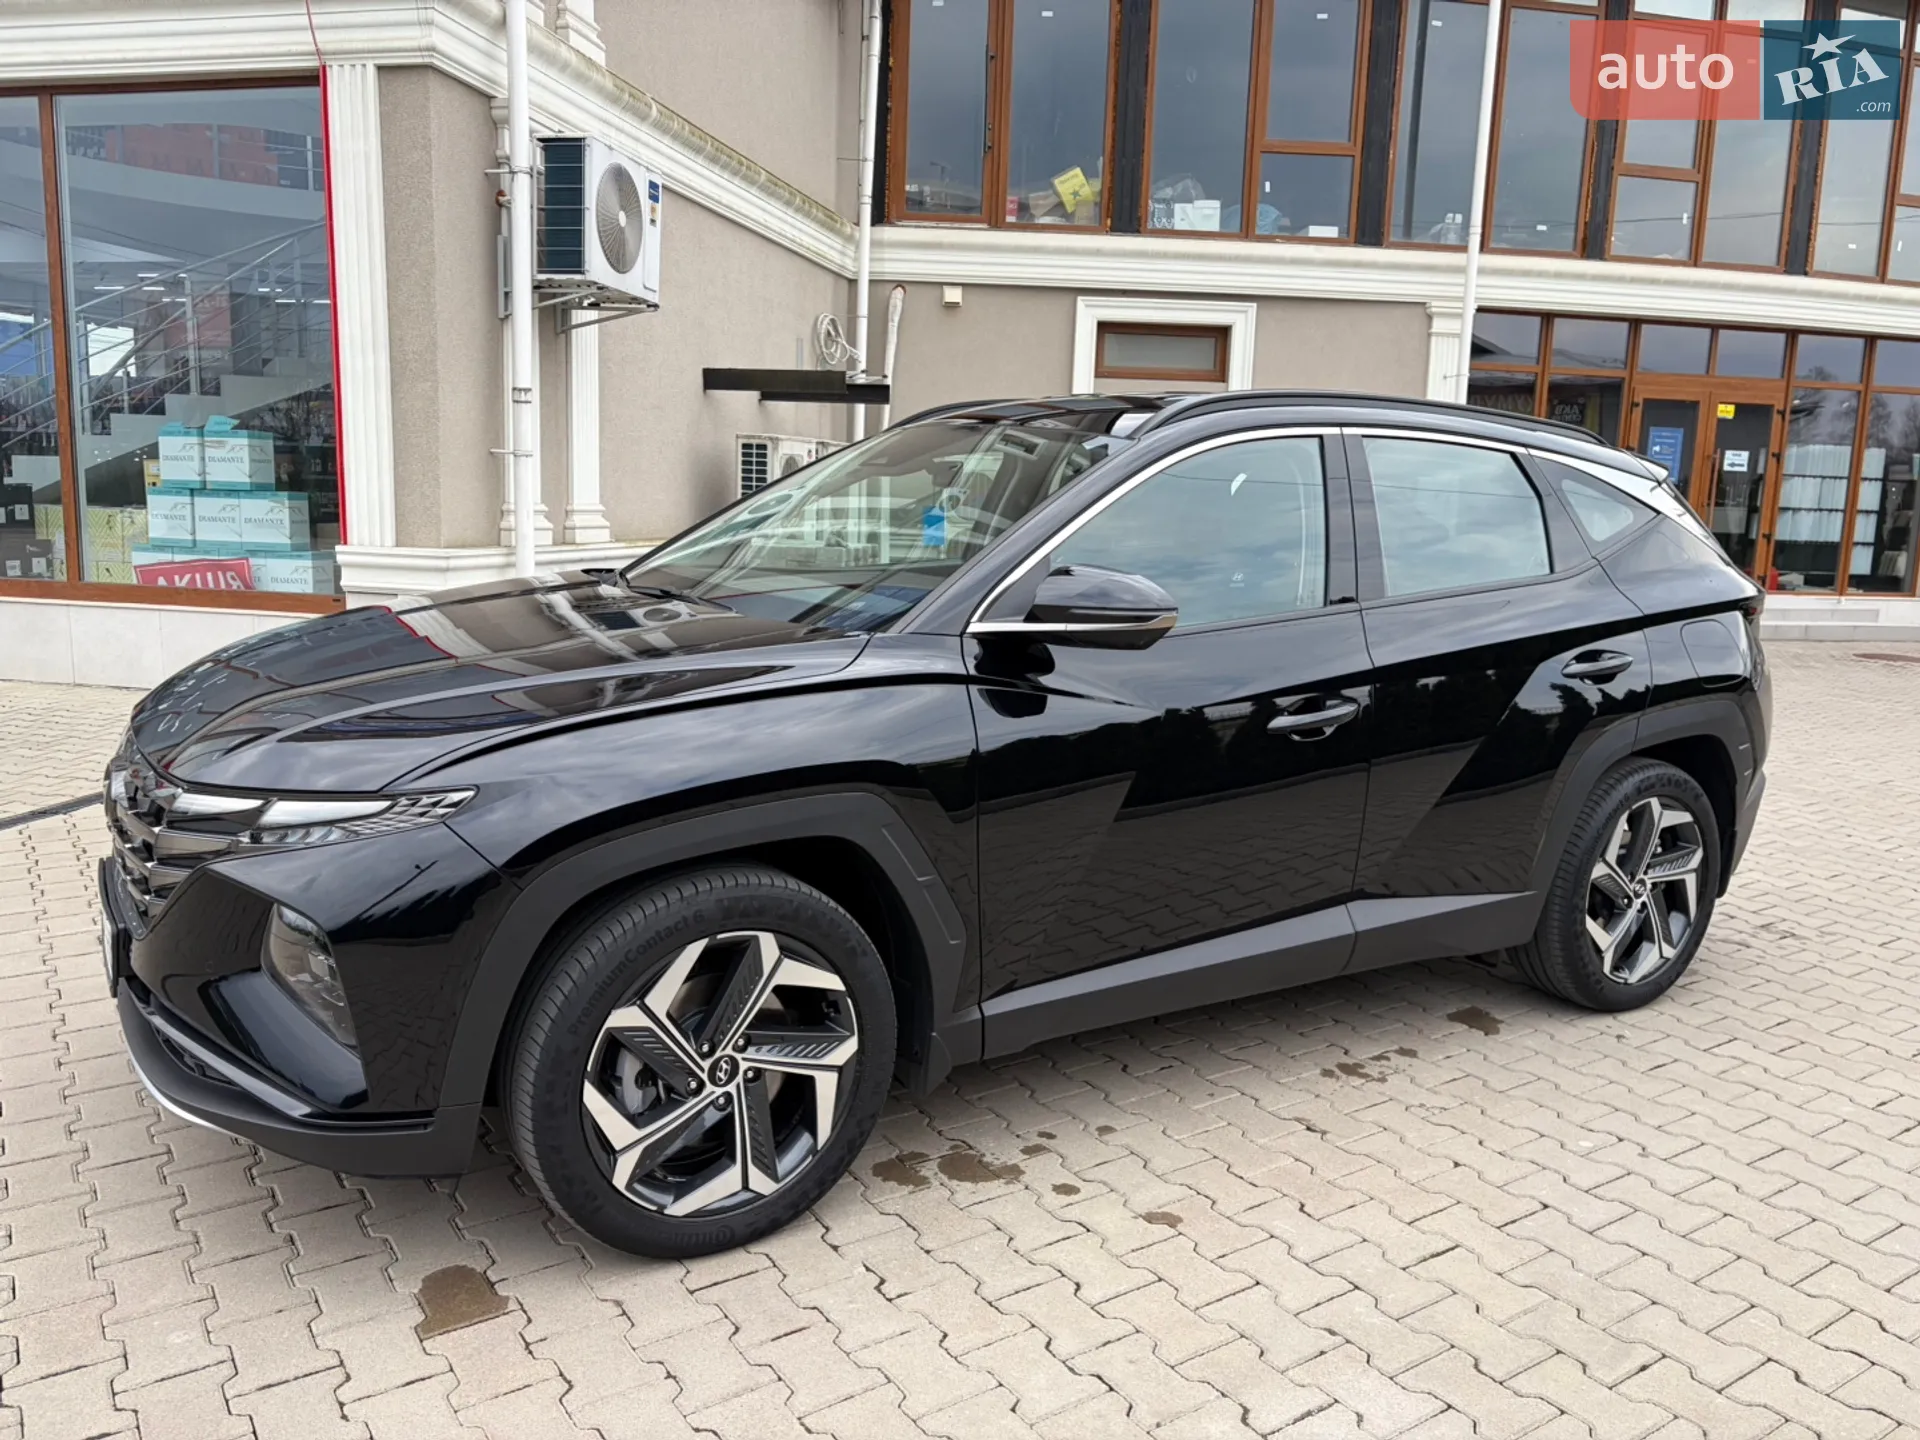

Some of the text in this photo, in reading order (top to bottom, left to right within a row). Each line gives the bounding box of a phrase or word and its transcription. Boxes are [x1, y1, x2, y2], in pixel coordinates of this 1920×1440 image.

[207, 456, 245, 464] DIAMANTE
[198, 515, 237, 524] DIAMANTE
[243, 517, 284, 526] DIAMANTE
[270, 577, 309, 586] DIAMANTE
[567, 909, 706, 1036] PremiumContact 6
